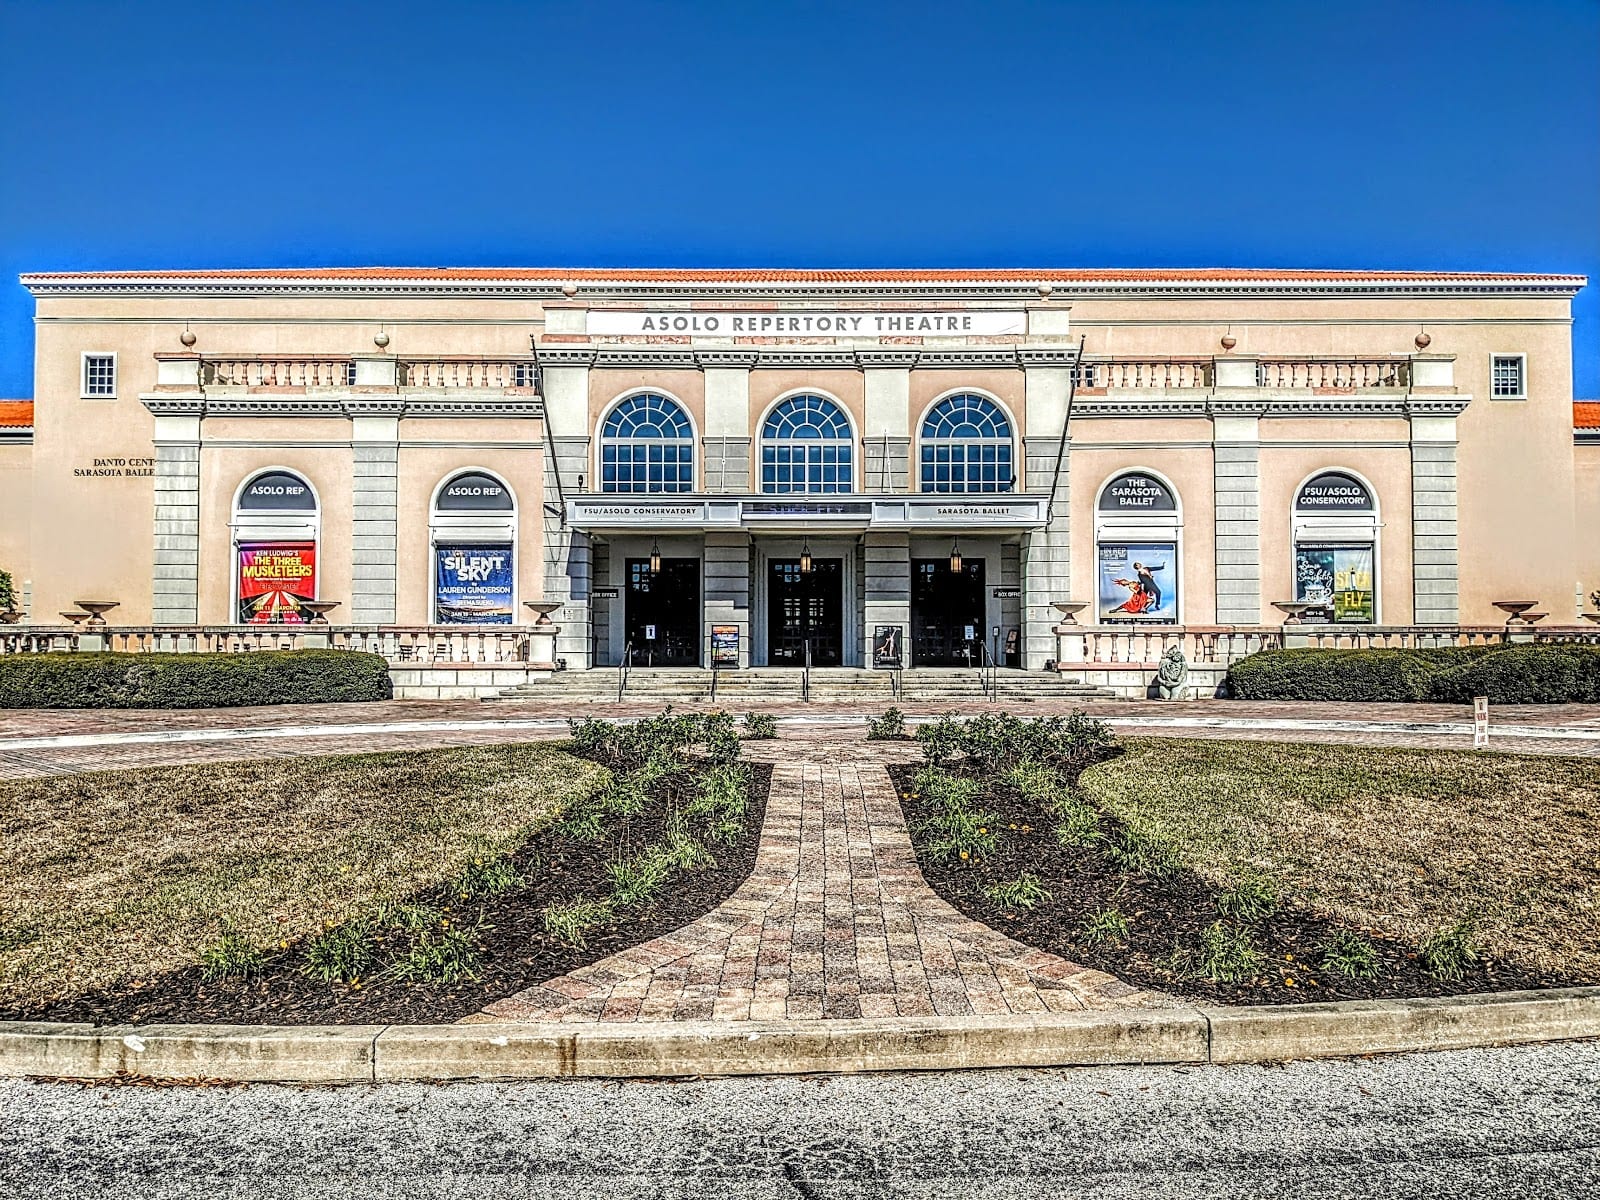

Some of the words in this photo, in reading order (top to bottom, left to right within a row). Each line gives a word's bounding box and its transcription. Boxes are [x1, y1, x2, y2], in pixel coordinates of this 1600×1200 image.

[642, 316, 719, 331] ASOLO
[732, 317, 862, 331] REPERTORY
[874, 316, 971, 331] THEATRE
[93, 458, 126, 467] DANTO
[73, 468, 122, 477] SARASOTA
[1127, 479, 1146, 487] THE
[250, 486, 284, 495] ASOLO
[286, 486, 305, 495] REP
[447, 487, 481, 496] ASOLO
[483, 487, 502, 496] REP
[1111, 488, 1162, 496] SARASOTA
[1304, 487, 1361, 496] FSU/ASOLO
[1120, 498, 1155, 506] BALLET
[1300, 496, 1366, 505] CONSERVATORY
[254, 556, 271, 565] THE
[273, 556, 302, 566] THREE
[444, 556, 505, 570] SILENT
[242, 565, 313, 578] MUSKETEERS
[457, 569, 491, 581] SKY
[438, 586, 466, 594] LAUREN
[467, 586, 511, 594] GUNDERSON
[1344, 591, 1364, 607] FLY
